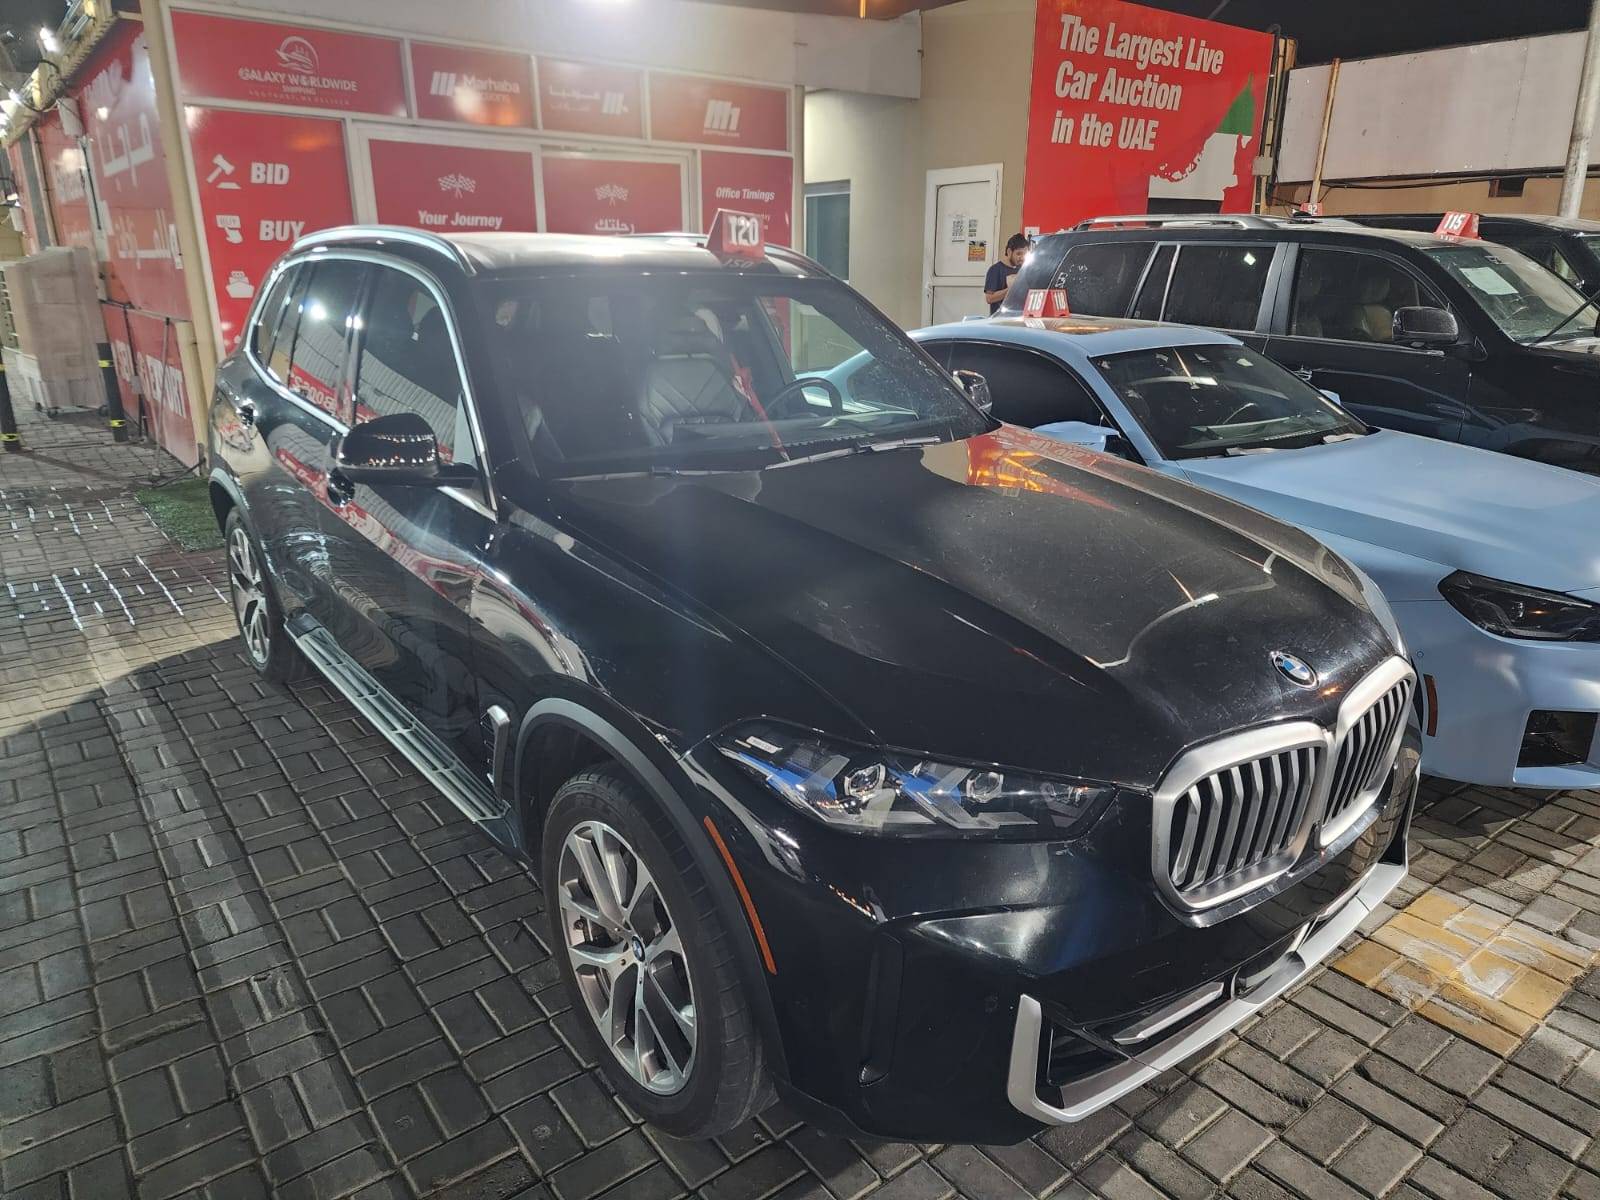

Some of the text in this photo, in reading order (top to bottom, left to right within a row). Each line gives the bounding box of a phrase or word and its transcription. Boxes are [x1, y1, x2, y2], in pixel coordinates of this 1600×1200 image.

[1060, 13, 1224, 74] The Largest Live
[238, 67, 286, 83] GALAXY
[463, 72, 520, 94] Marhaba
[1055, 60, 1182, 111] Car Auction
[1051, 110, 1159, 151] in the UAE
[250, 162, 289, 185] BID
[716, 186, 775, 202] Office Timings
[259, 219, 305, 242] BUY
[418, 209, 502, 230] Your Journey
[728, 214, 759, 247] 120
[1443, 214, 1465, 230] 115
